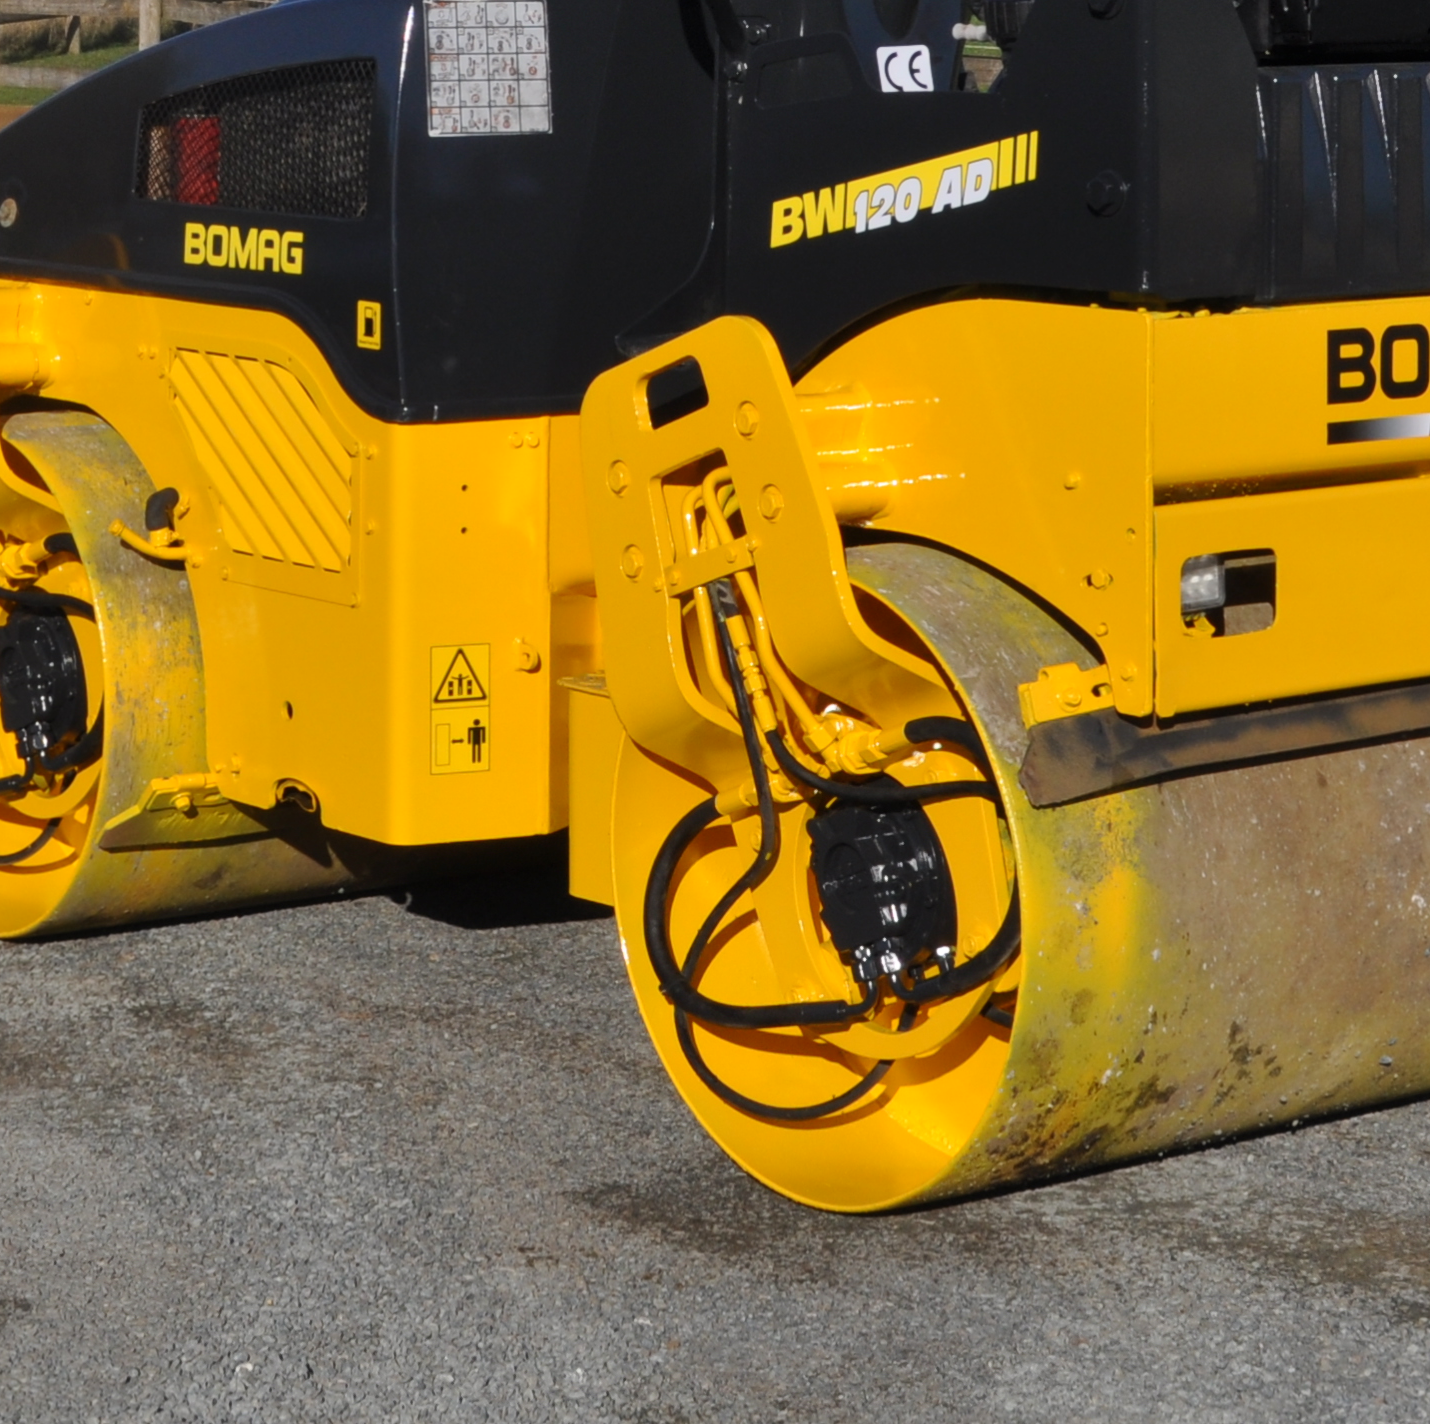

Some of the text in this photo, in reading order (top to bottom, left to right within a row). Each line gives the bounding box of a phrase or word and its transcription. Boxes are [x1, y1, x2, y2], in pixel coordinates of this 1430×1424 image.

[770, 157, 994, 249] BW 120 AD
[184, 222, 304, 275] BOMAG
